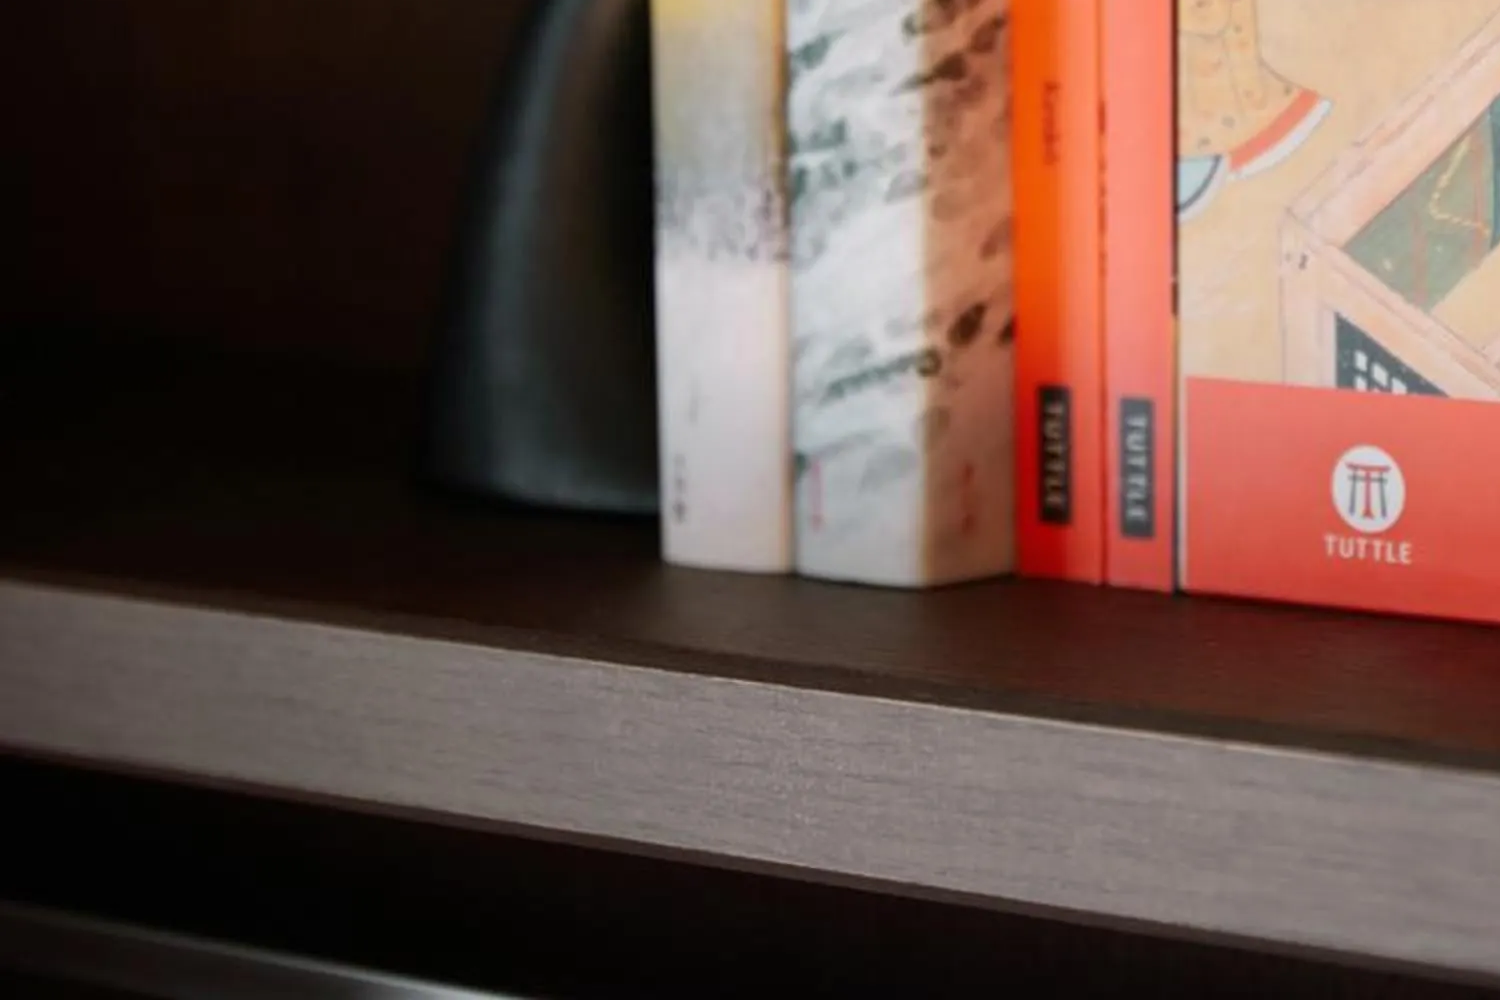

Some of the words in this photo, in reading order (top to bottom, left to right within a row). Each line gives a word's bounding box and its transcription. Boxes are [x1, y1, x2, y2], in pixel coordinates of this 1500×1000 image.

[1042, 401, 1068, 515] TUTTLE
[1125, 412, 1150, 523] TUTTLE
[1323, 533, 1413, 565] TUTTLE
